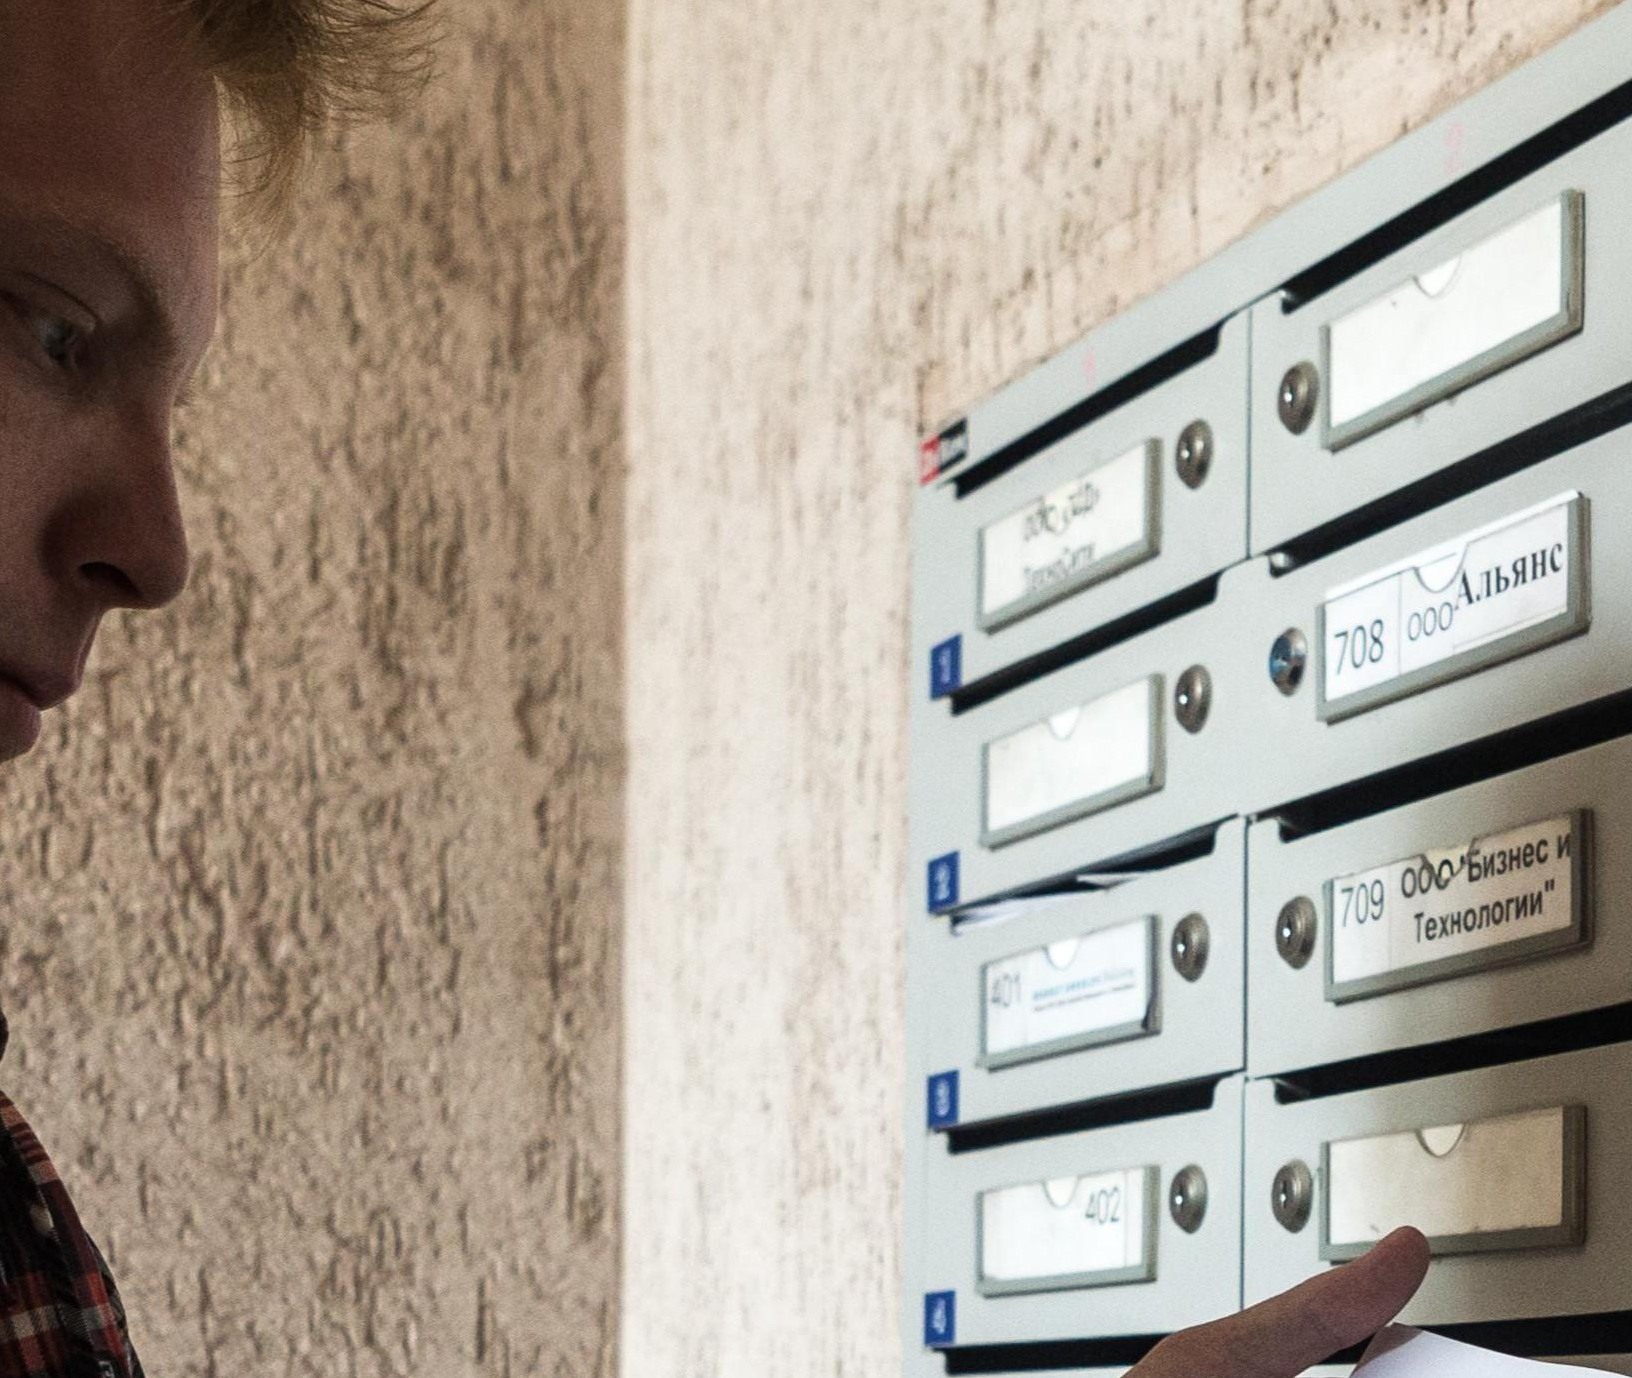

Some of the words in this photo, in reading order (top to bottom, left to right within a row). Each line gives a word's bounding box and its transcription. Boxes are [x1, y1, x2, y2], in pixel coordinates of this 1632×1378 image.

[1454, 542, 1564, 611] Альянс
[1334, 618, 1385, 676] 708
[1339, 877, 1386, 928] 709
[1400, 857, 1455, 898] ООО
[1413, 878, 1556, 944] Технологии"
[1084, 1186, 1120, 1225] 402
